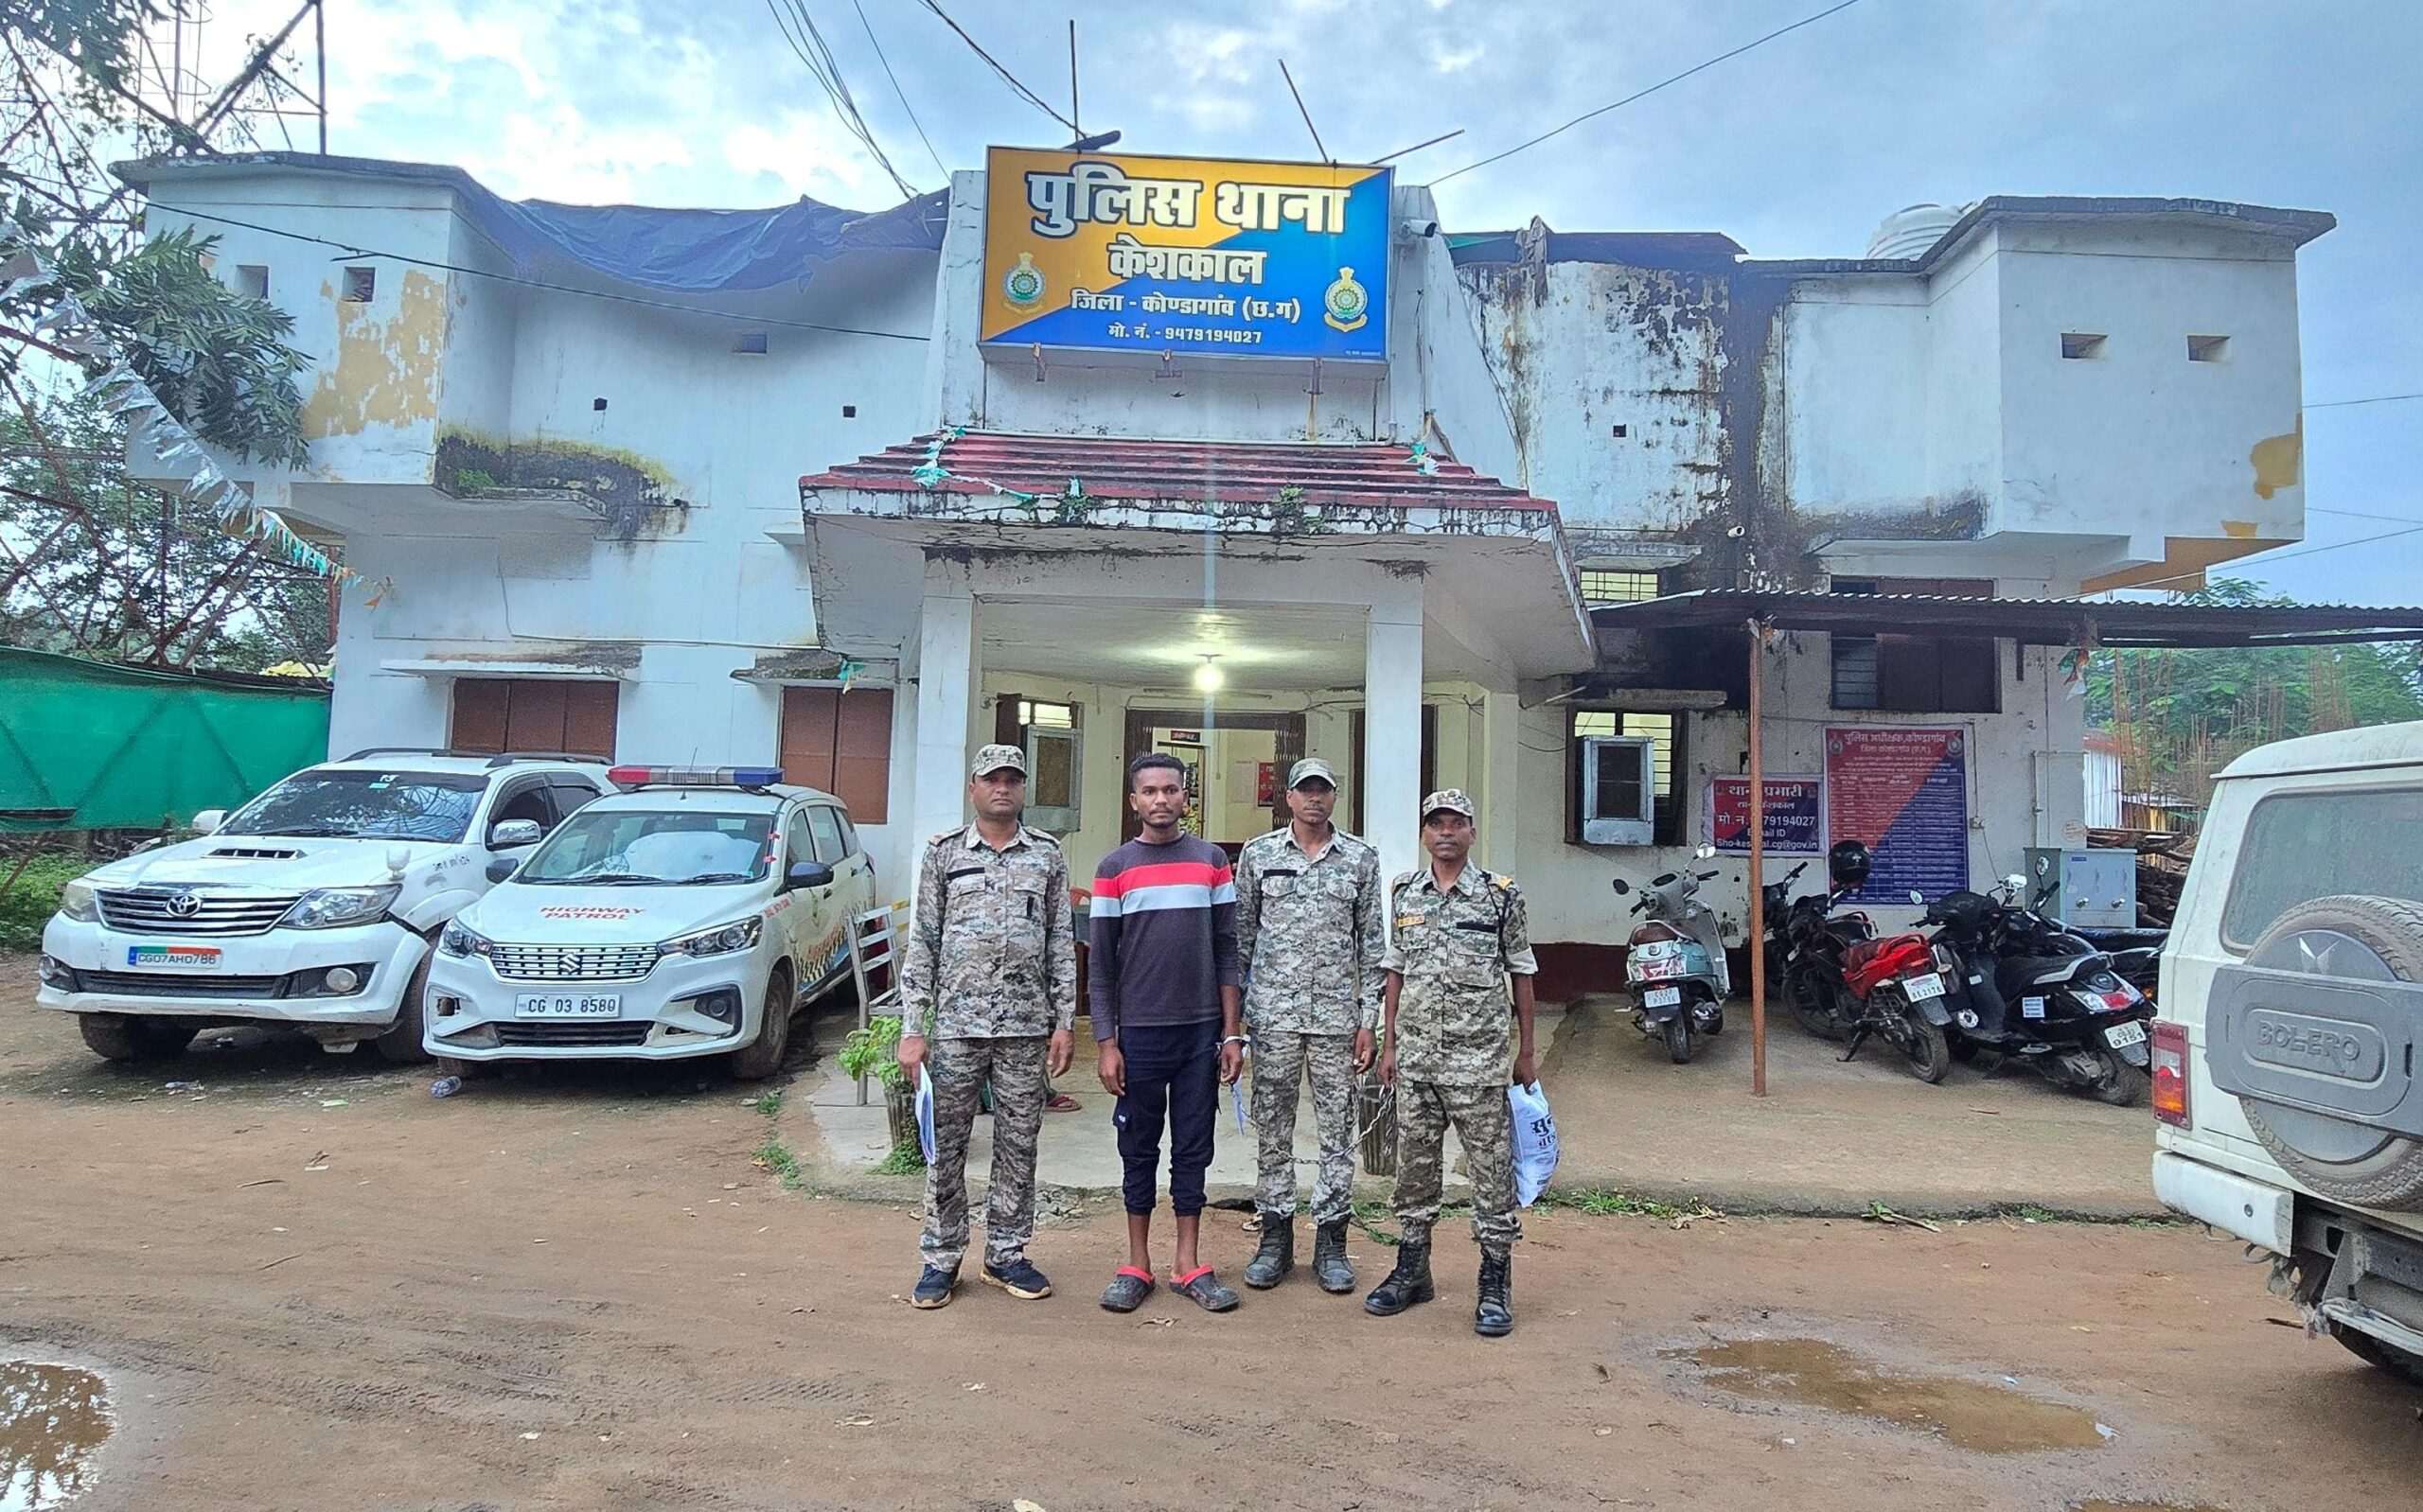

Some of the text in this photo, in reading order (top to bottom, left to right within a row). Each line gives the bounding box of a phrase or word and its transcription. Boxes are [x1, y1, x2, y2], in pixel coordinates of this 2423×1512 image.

[1025, 161, 1352, 237] पुलिस थाना
[1107, 233, 1267, 284] केशकाल
[1070, 288, 1124, 310] जिला
[1141, 291, 1235, 316] कोण्डागांव
[1242, 296, 1300, 323] (छ.ग)
[1165, 327, 1262, 343] 9479194027
[1763, 816, 1815, 826] 79194027
[529, 998, 546, 1012] CG
[555, 998, 573, 1012] 03
[2256, 1020, 2361, 1061] BOLERO
